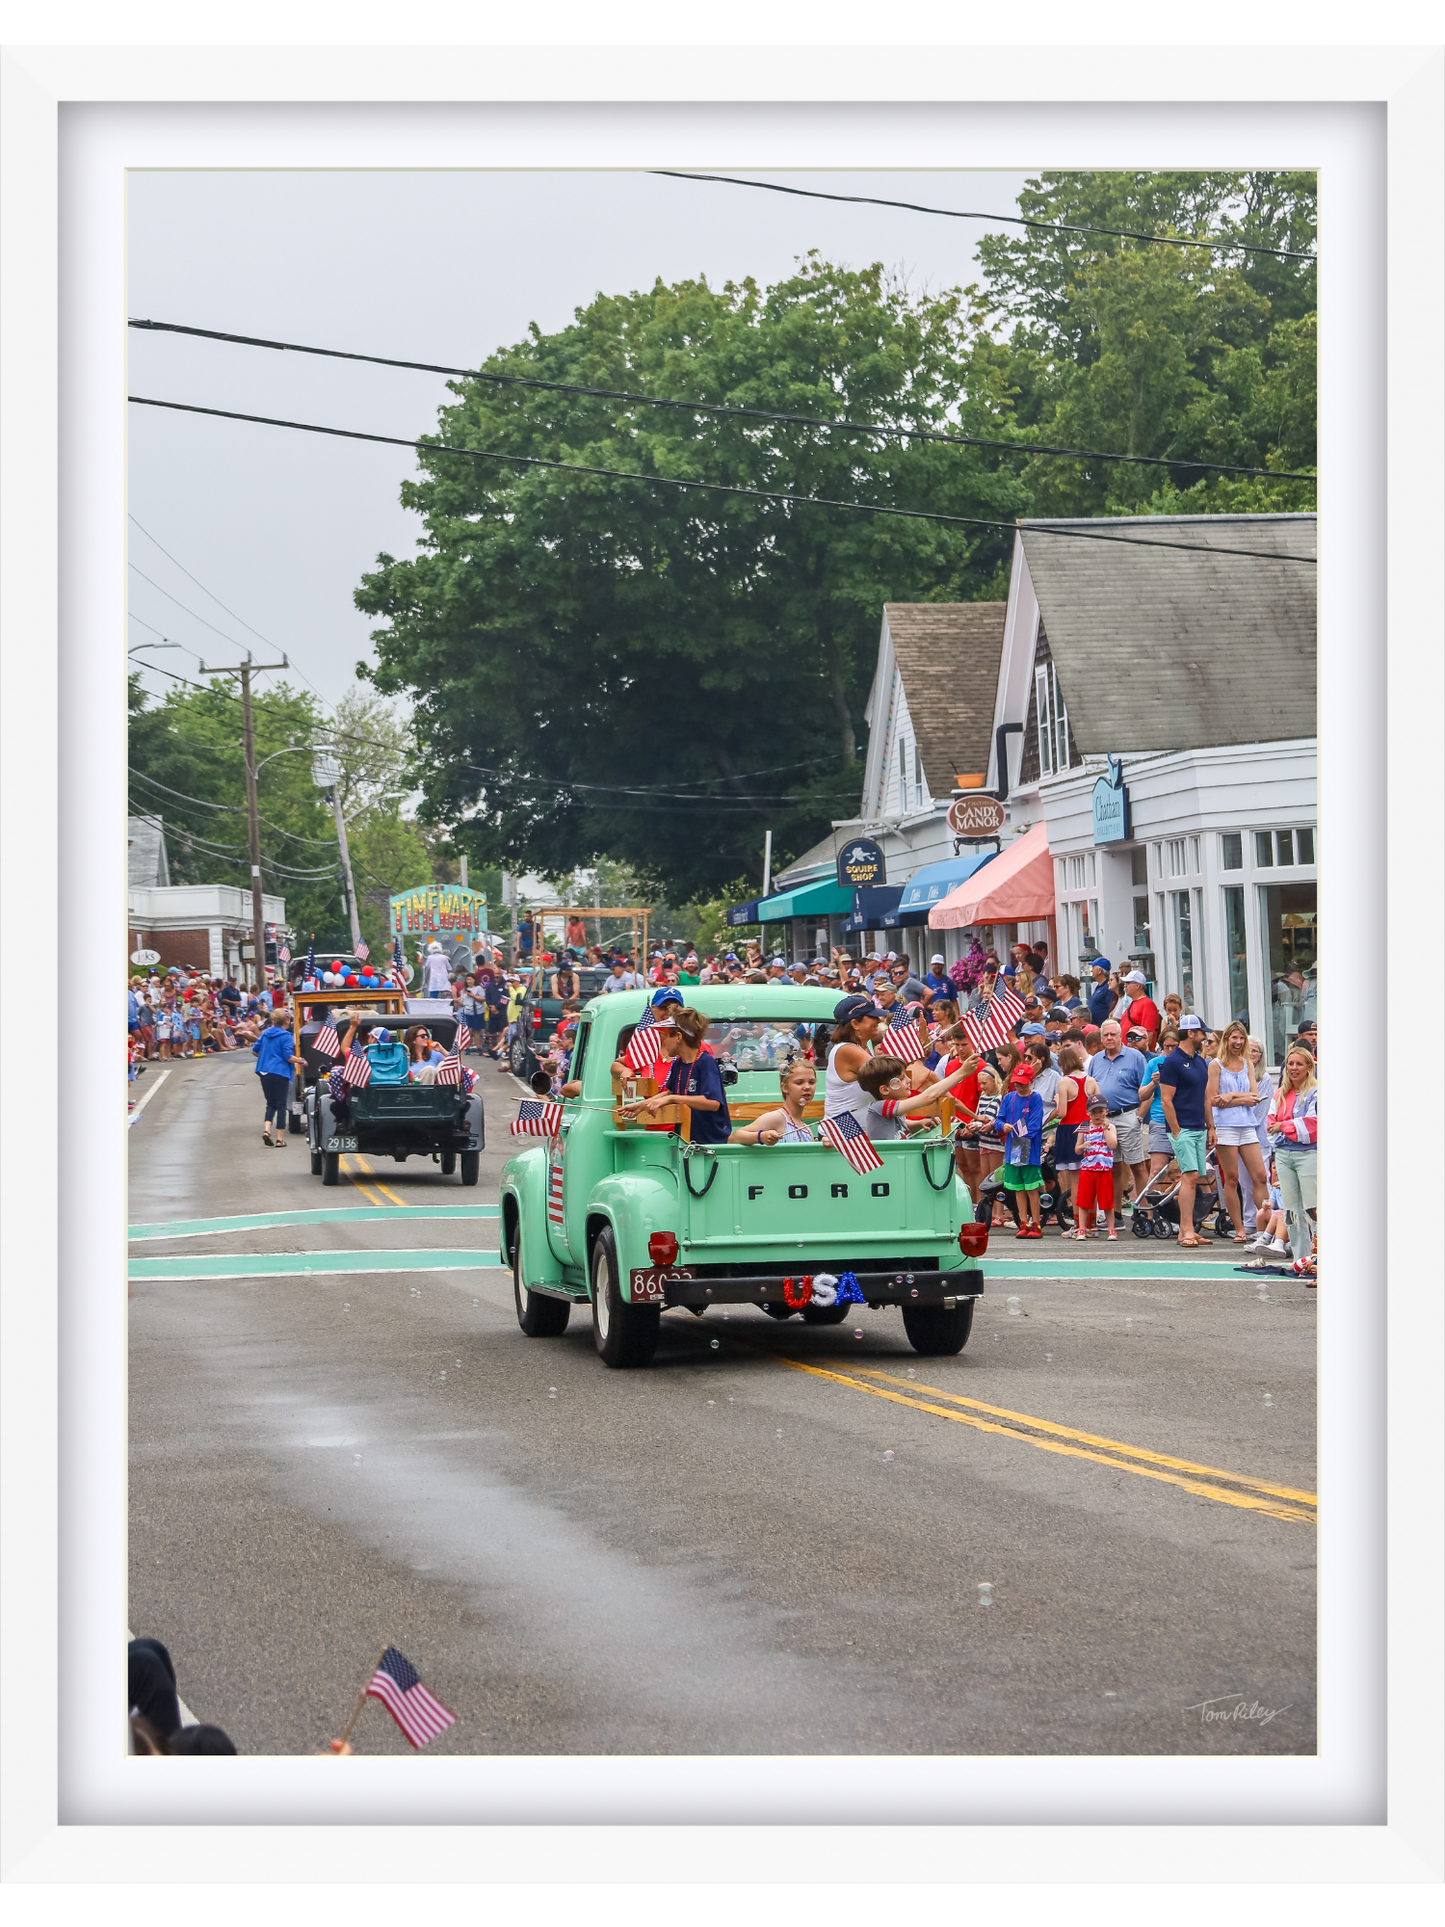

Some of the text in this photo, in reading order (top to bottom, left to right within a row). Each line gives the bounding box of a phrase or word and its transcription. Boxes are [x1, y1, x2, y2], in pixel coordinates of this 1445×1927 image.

[954, 802, 999, 818] CANDY
[1095, 793, 1121, 822] Chatham
[956, 816, 1000, 830] MANOR
[845, 863, 878, 874] SQUIRE
[850, 872, 874, 882] SHOP
[328, 1136, 357, 1149] 29136
[748, 1182, 890, 1200] FORD
[782, 1271, 867, 1309] USA
